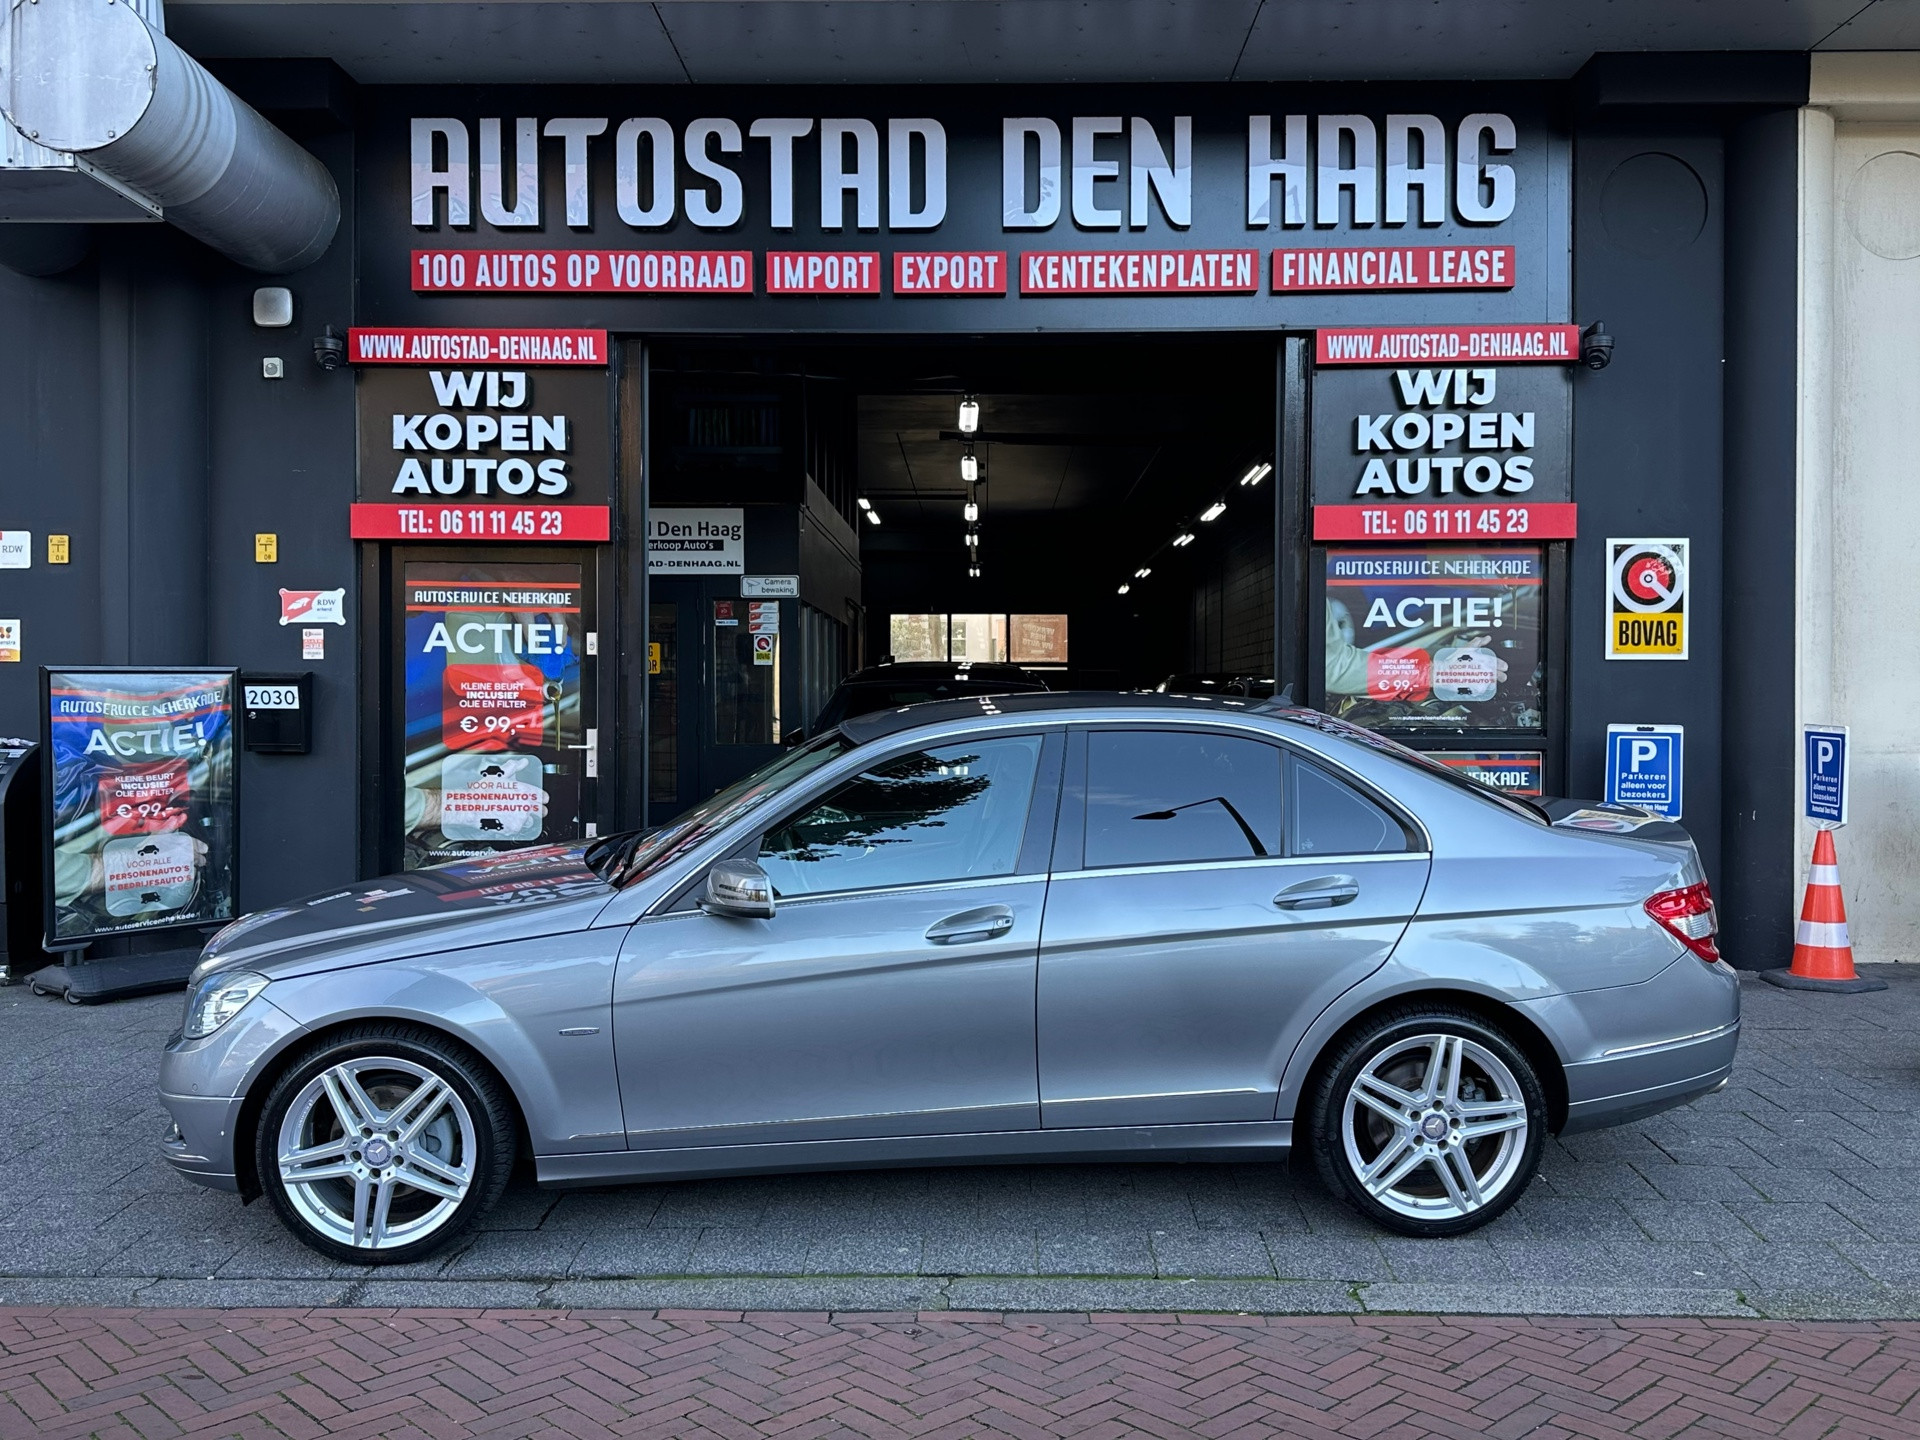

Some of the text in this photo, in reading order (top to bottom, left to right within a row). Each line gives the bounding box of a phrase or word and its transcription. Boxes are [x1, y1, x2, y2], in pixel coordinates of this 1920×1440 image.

[411, 113, 1516, 229] AUTOSTAD DEN HAAG
[419, 255, 746, 288] 100 AUTOS OP VOORRAAD
[773, 256, 873, 289] IMPORT
[901, 256, 998, 289] EXPORT
[1027, 254, 1252, 288] KENTEKENPLATEN
[1283, 249, 1505, 286] FINANCIAL LEASE
[358, 335, 598, 362] WWW.AUTOSTAD-DENHAAG.NL
[1327, 331, 1569, 359] WWW.AUTOSTAD-DENHAAG.NL
[429, 371, 528, 408] WIJ
[1397, 368, 1496, 405] WIJ
[392, 415, 567, 451] KOPEN
[1357, 412, 1535, 450] KOPEN
[392, 458, 569, 495] AUTOS
[1356, 456, 1534, 494] AUTOS
[399, 510, 562, 535] TEL: 06 11 11 45 23
[658, 522, 742, 540] Den Haag
[1363, 509, 1529, 534] TEL: 06 11 11 45 23
[1336, 560, 1531, 575] AUTOSERVICE NEHERKADE
[414, 591, 572, 605] AUTOSERVICE NEHERKADE
[1363, 598, 1502, 628] ACTIE!
[423, 622, 564, 654] ACTIE!
[1618, 620, 1678, 647] BOVAG
[248, 690, 295, 705] 2030
[494, 682, 525, 690] BEURT
[1378, 680, 1419, 692] € 99,-
[60, 690, 222, 716] AUTOSERVICE NEHERKADE
[460, 716, 526, 735] € 99,-
[83, 722, 207, 756] ACTIE!
[1631, 740, 1657, 772] P
[1818, 740, 1834, 774] P
[115, 773, 174, 783] KLEINE BEURT
[121, 780, 169, 790] INCLUSIEF
[1621, 773, 1666, 781] Parkeren
[1813, 773, 1838, 783] Parkeren
[1813, 783, 1826, 791] alleen
[115, 789, 135, 798] OLIE
[150, 787, 174, 796] FILTER
[1813, 792, 1836, 802] bezoekers
[116, 803, 174, 818] € 99,-
[109, 865, 190, 881] PERSONENAUTO'S
[126, 860, 150, 868] VOOR
[118, 875, 192, 891] BEDRIJFSAUTO'S
